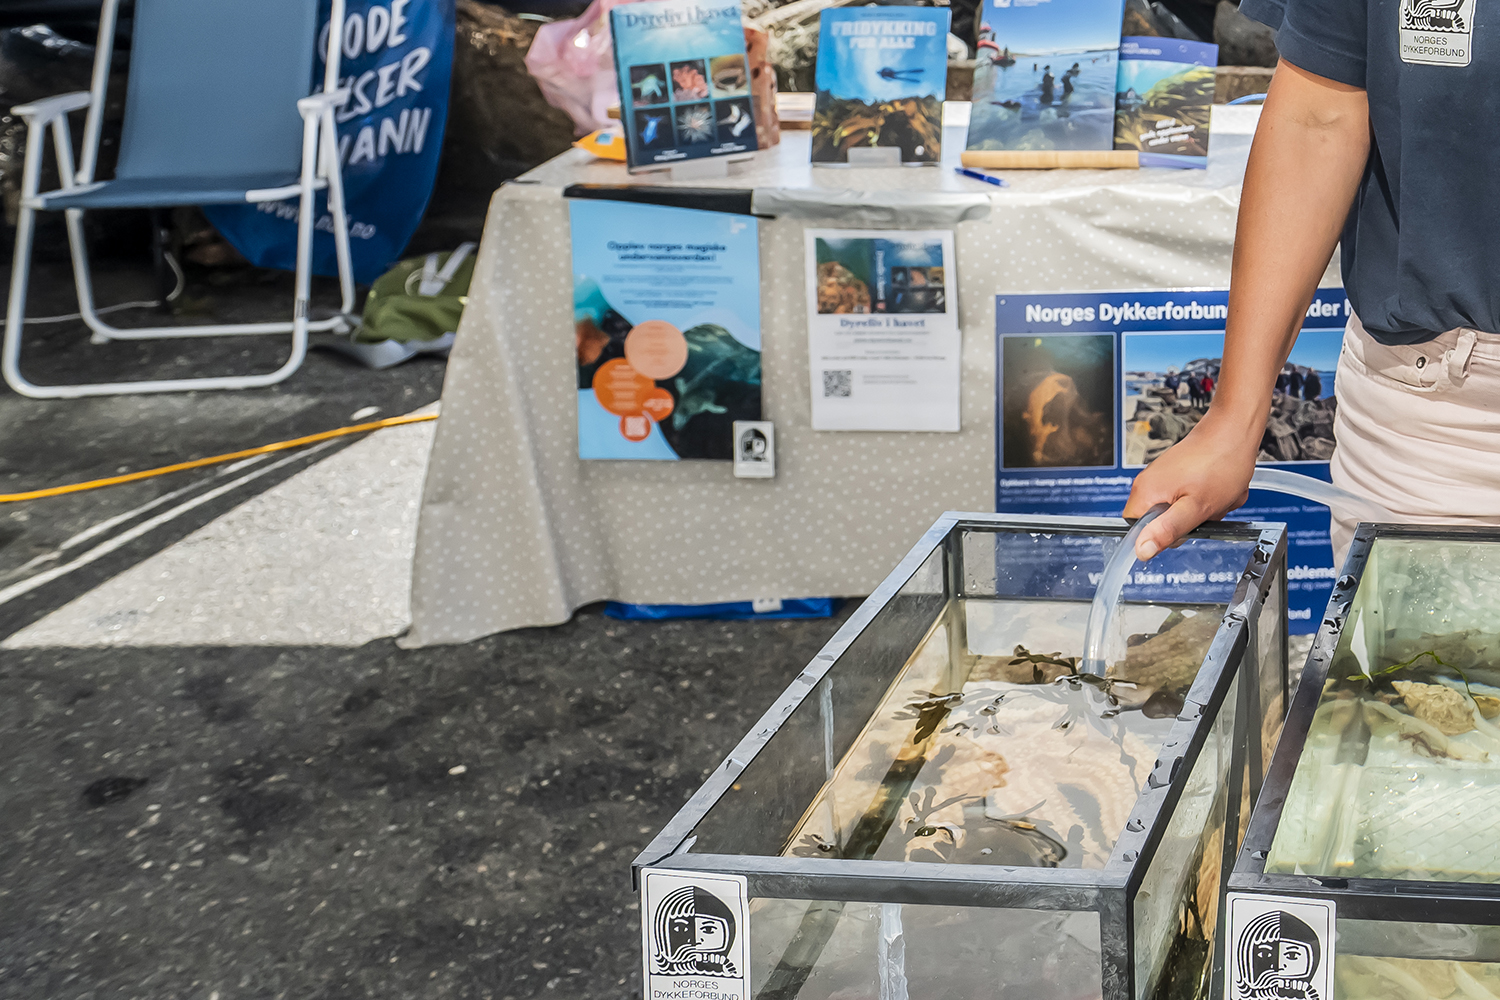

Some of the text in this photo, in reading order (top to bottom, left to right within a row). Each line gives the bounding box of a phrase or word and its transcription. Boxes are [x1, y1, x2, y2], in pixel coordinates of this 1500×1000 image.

[830, 20, 937, 37] FRIDYKKING
[1413, 35, 1448, 46] NORGES
[1403, 44, 1465, 58] DYKKEFORBUND
[1026, 303, 1094, 326] Norges
[1098, 300, 1229, 326] Dykkerforbun
[1305, 298, 1340, 319] der
[673, 979, 719, 990] NORGES
[653, 989, 739, 1000] DYKKEFORBUND
